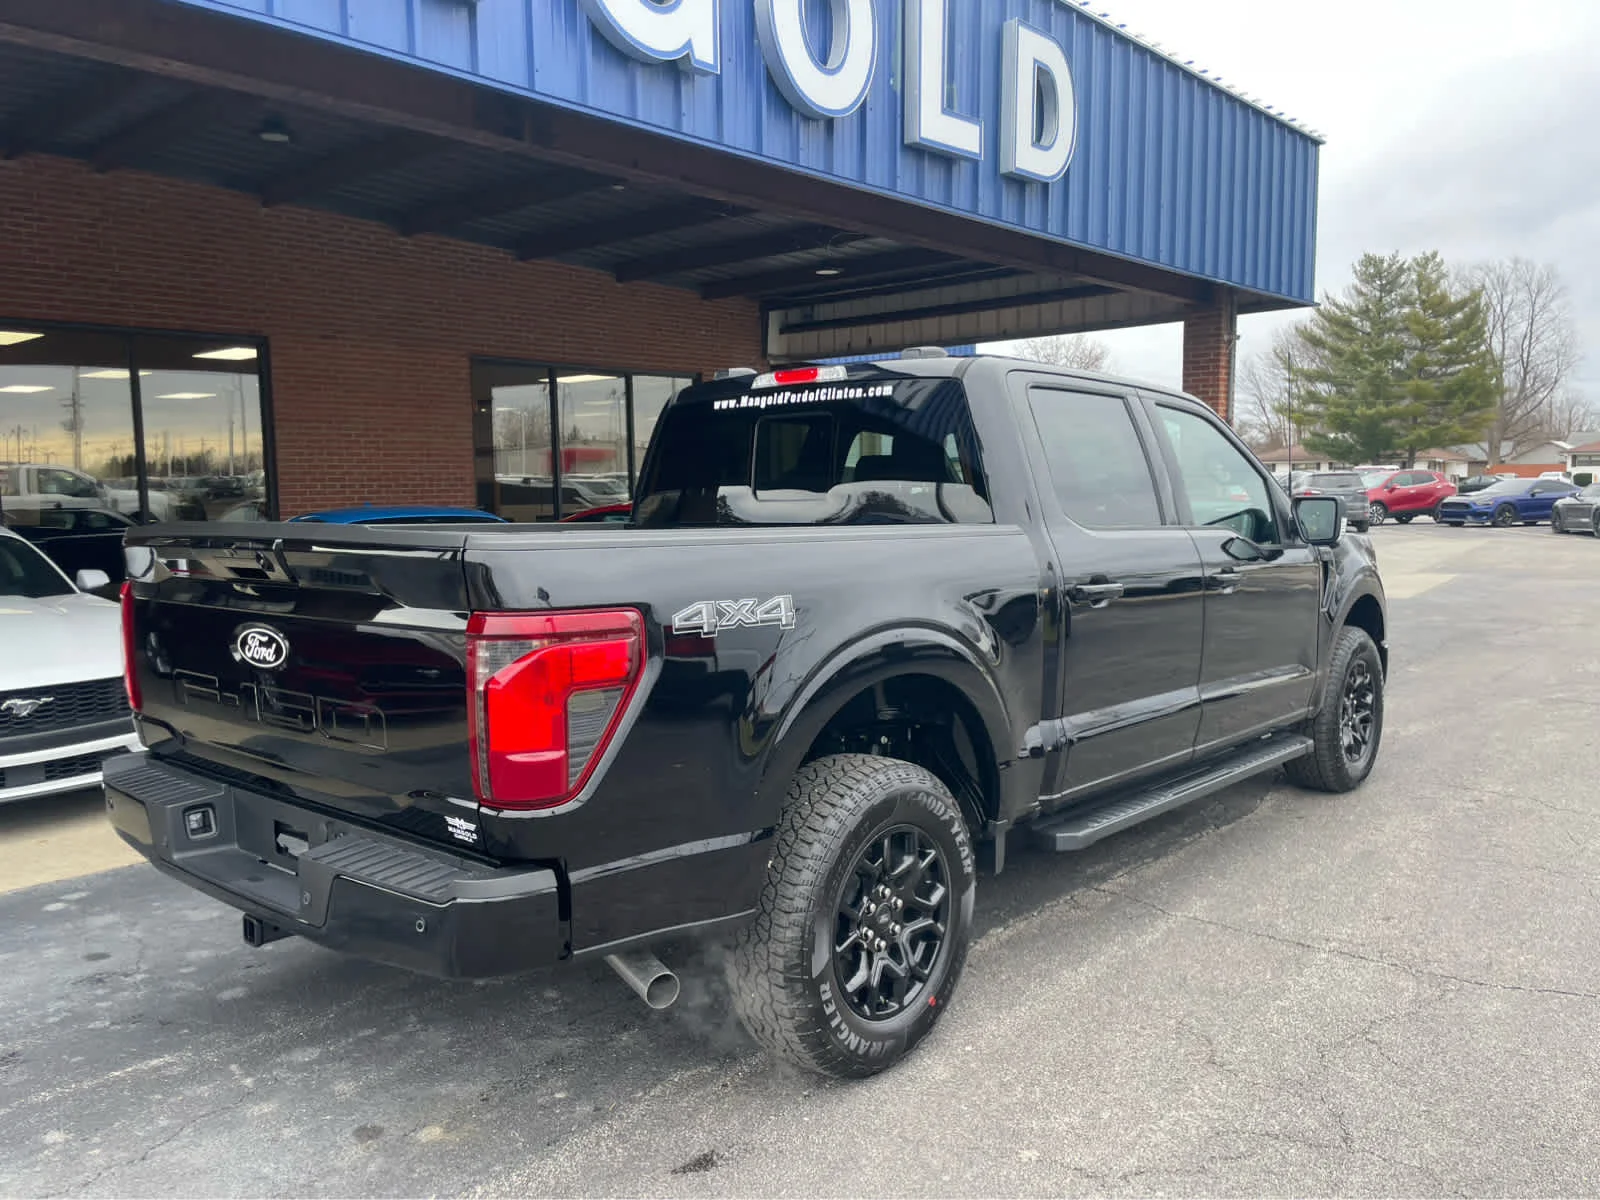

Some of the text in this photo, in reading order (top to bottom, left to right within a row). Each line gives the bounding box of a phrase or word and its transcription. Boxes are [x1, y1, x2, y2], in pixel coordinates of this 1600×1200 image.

[713, 385, 893, 410] www.MangoldFordofClinton.com
[244, 632, 276, 662] Ford
[173, 668, 388, 751] F-150
[906, 791, 974, 875] GOODYEAR
